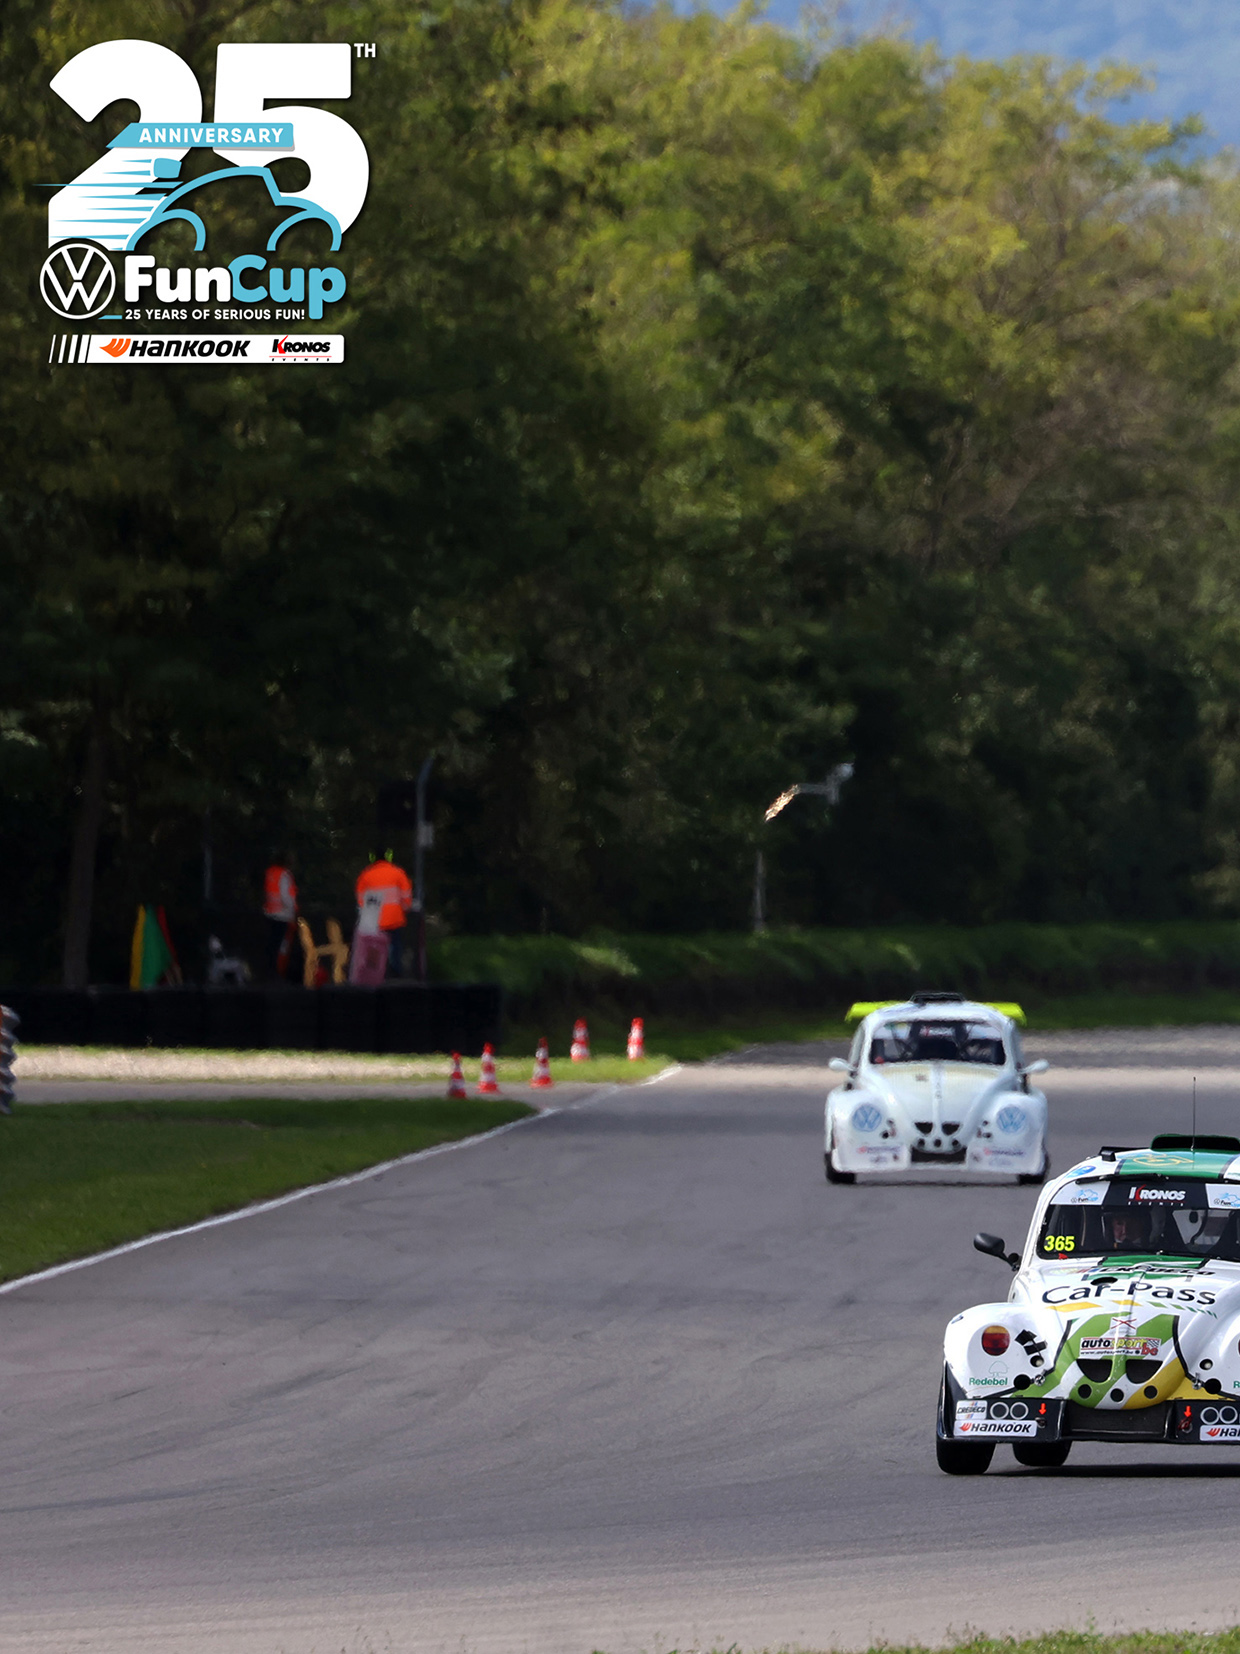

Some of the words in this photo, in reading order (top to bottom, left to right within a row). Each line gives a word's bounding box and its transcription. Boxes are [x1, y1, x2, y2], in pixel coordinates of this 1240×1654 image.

[1129, 1184, 1186, 1200] KRONOS
[1044, 1235, 1075, 1252] 365
[1042, 1280, 1216, 1305] Car-Pass
[969, 1377, 1008, 1386] Redebel
